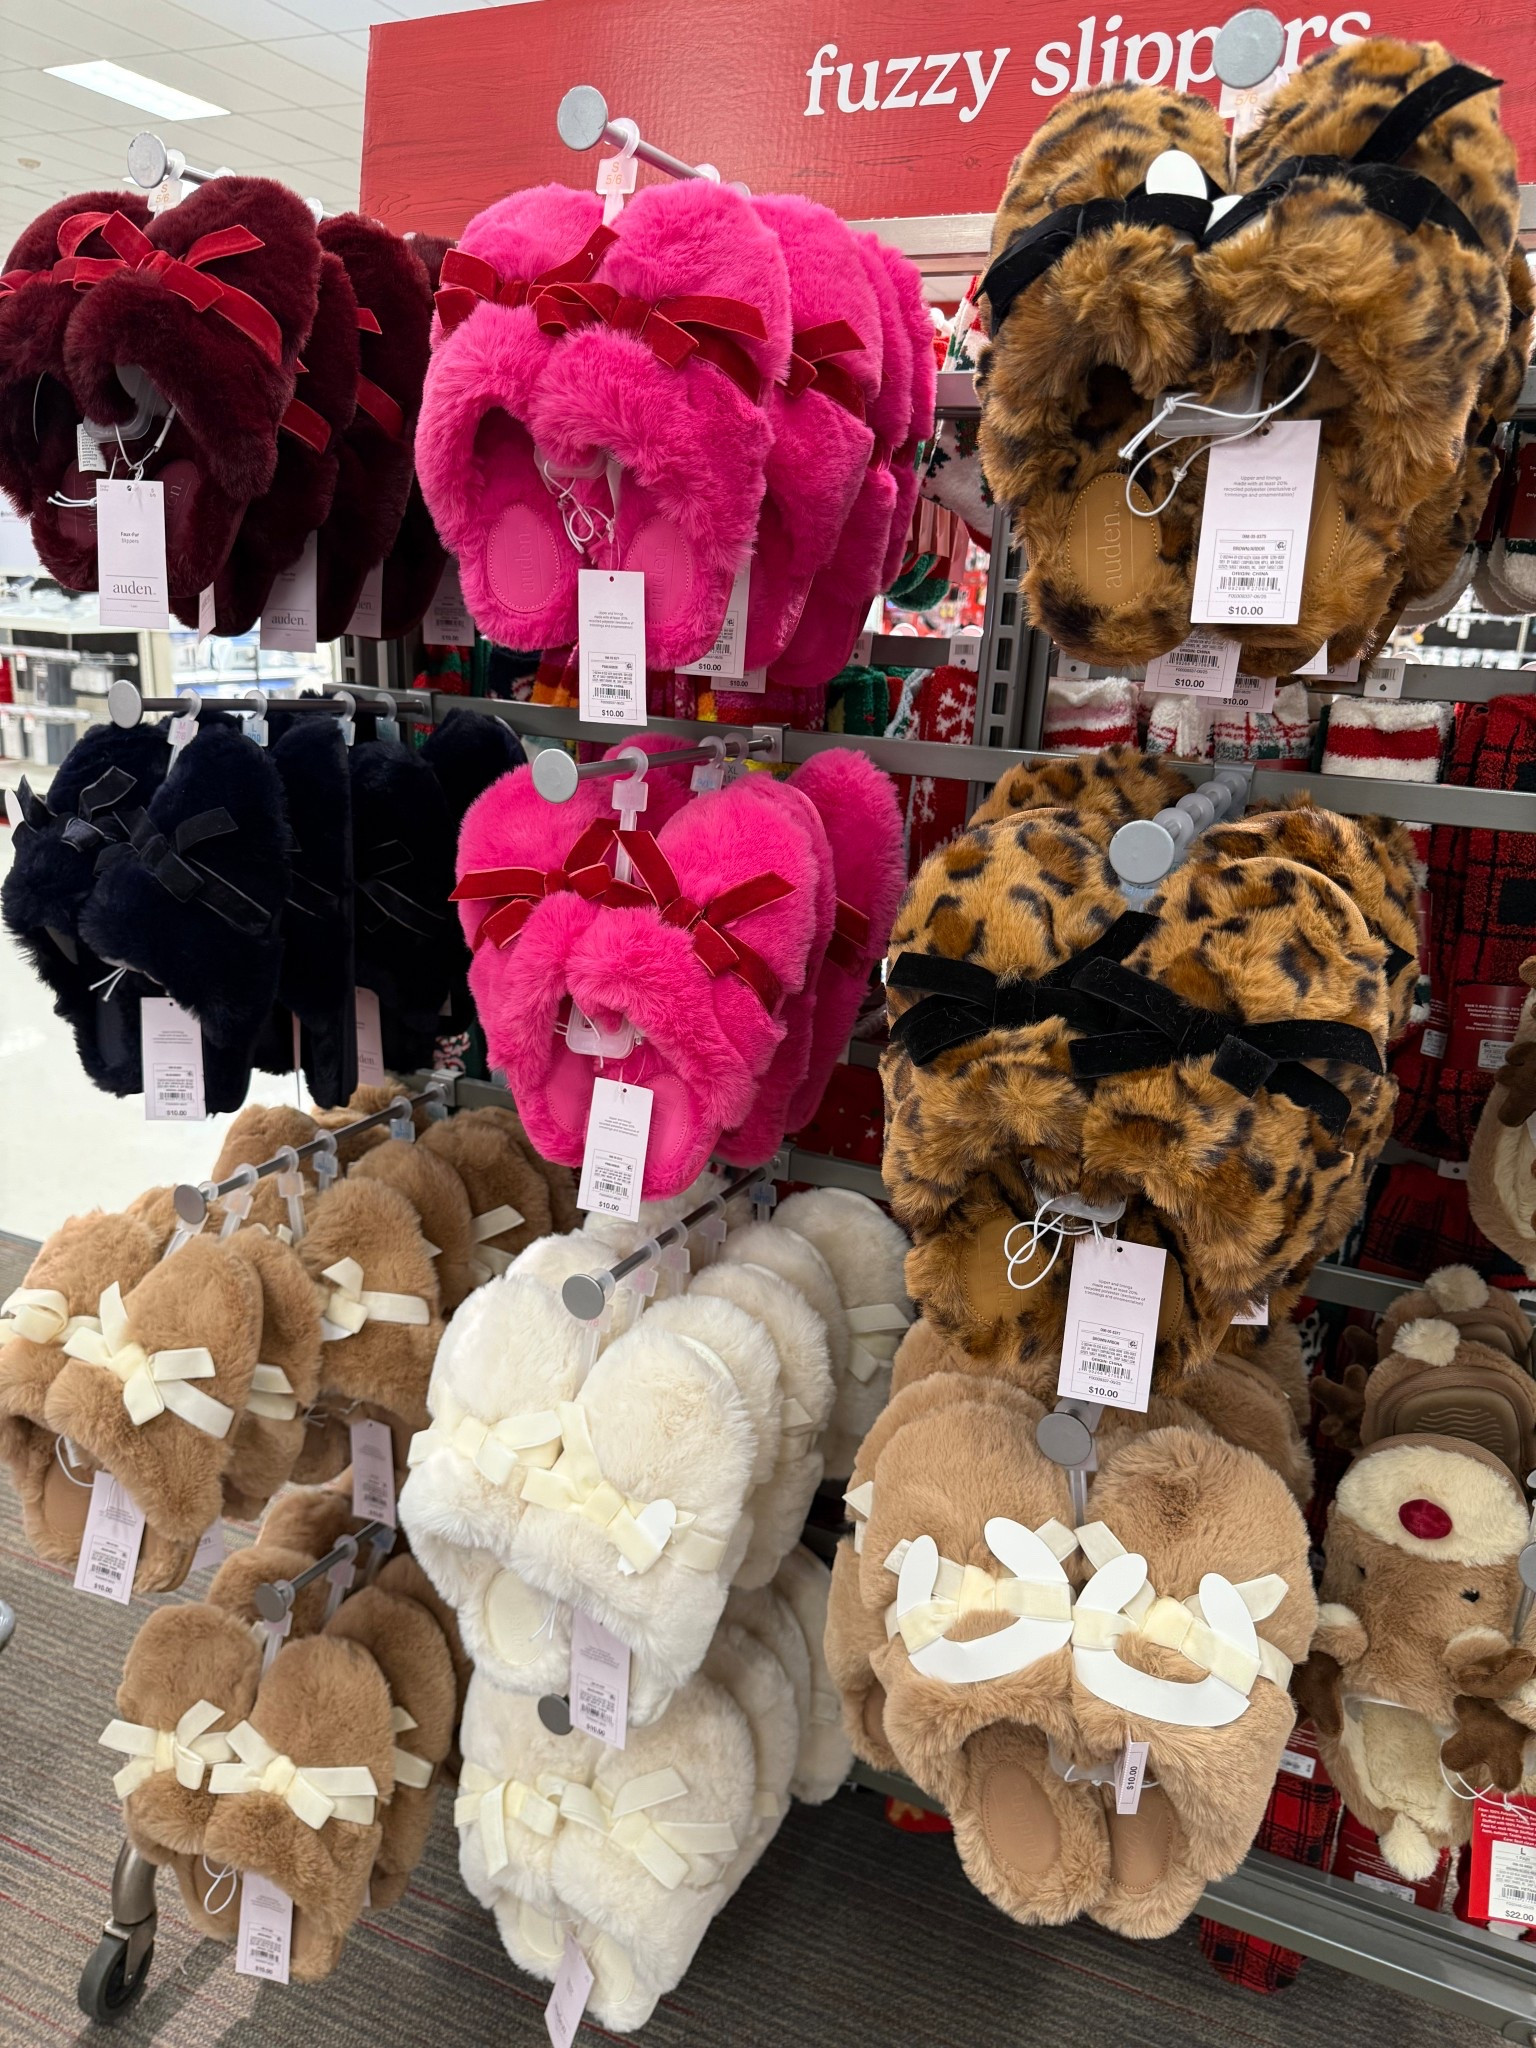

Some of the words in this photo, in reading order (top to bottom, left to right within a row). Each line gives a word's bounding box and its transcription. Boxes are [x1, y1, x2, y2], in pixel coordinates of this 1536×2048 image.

[803, 44, 1010, 122] fuzzy
[1031, 11, 1370, 97] slipprs
[1235, 93, 1257, 105] 5/6
[612, 162, 619, 172] S
[606, 174, 622, 184] 5/6
[161, 184, 168, 192] S
[1097, 512, 1122, 588] auden
[515, 533, 535, 593] auden
[113, 581, 153, 595] auden
[1228, 606, 1263, 615] $10.00
[272, 614, 304, 626] auden
[1174, 679, 1204, 687] $10.00
[1223, 698, 1248, 706] $10.00
[602, 710, 624, 718] $10.00
[728, 766, 736, 774] XL
[599, 1201, 619, 1211] $10.00
[1088, 1386, 1118, 1398] $10.00
[1127, 1766, 1137, 1790] $10.00
[1520, 1847, 1526, 1855] L
[1505, 1910, 1534, 1921] $22.00
